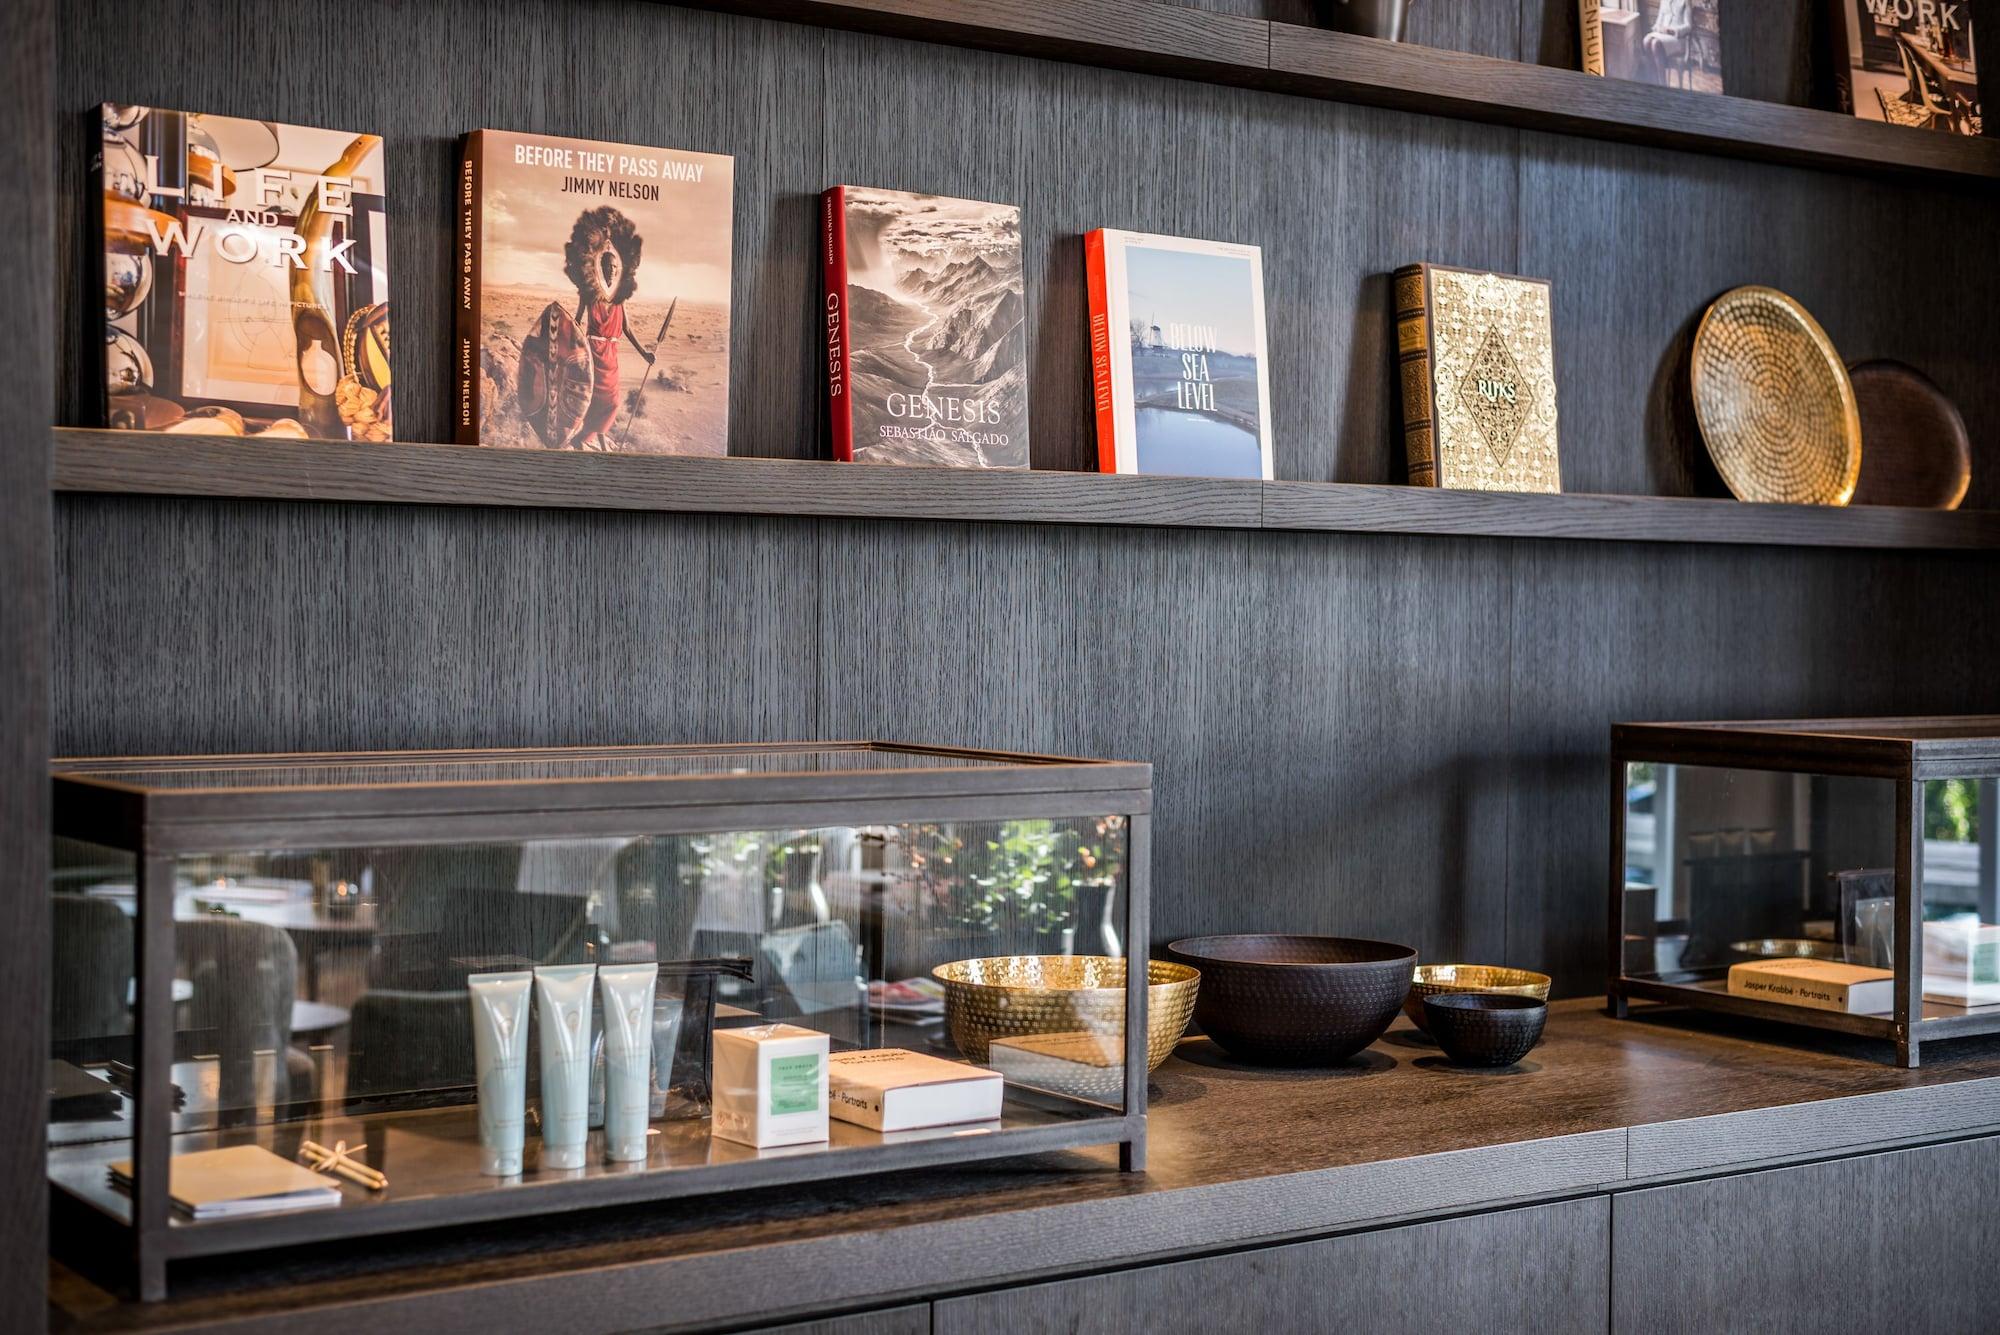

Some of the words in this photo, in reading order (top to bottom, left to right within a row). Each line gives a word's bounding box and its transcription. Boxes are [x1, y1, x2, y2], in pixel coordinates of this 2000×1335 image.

[1866, 0, 1960, 31] WORK
[514, 143, 573, 169] BEFORE
[577, 151, 615, 174] THEY
[619, 155, 658, 178] PASS
[662, 160, 704, 183] AWAY
[144, 154, 354, 218] LIFE
[464, 160, 473, 206] BEFORE
[561, 176, 605, 196] JIMMY
[608, 181, 660, 201] NELSON
[226, 208, 279, 228] AND
[464, 209, 472, 240] THEY
[145, 219, 359, 275] WORK
[463, 242, 472, 274] PASS
[463, 276, 472, 310] AWAY
[827, 292, 842, 397] GENESIS
[1169, 322, 1218, 353] BELOW
[463, 338, 471, 377] JIMMY
[1095, 355, 1108, 378] SEA
[1182, 353, 1210, 382] SEA
[462, 380, 470, 426] NELSON
[1097, 380, 1110, 412] LEVEL
[1177, 381, 1218, 412] LEVEL
[1477, 379, 1517, 404] RIJKS
[886, 392, 1001, 425] GENESIS
[879, 425, 946, 440] SEBASTIÃO
[951, 431, 1009, 446] SALGADO
[1744, 980, 1767, 992] Jasper
[1800, 989, 1831, 1001] Portraits
[841, 1089, 868, 1110] Portraits
